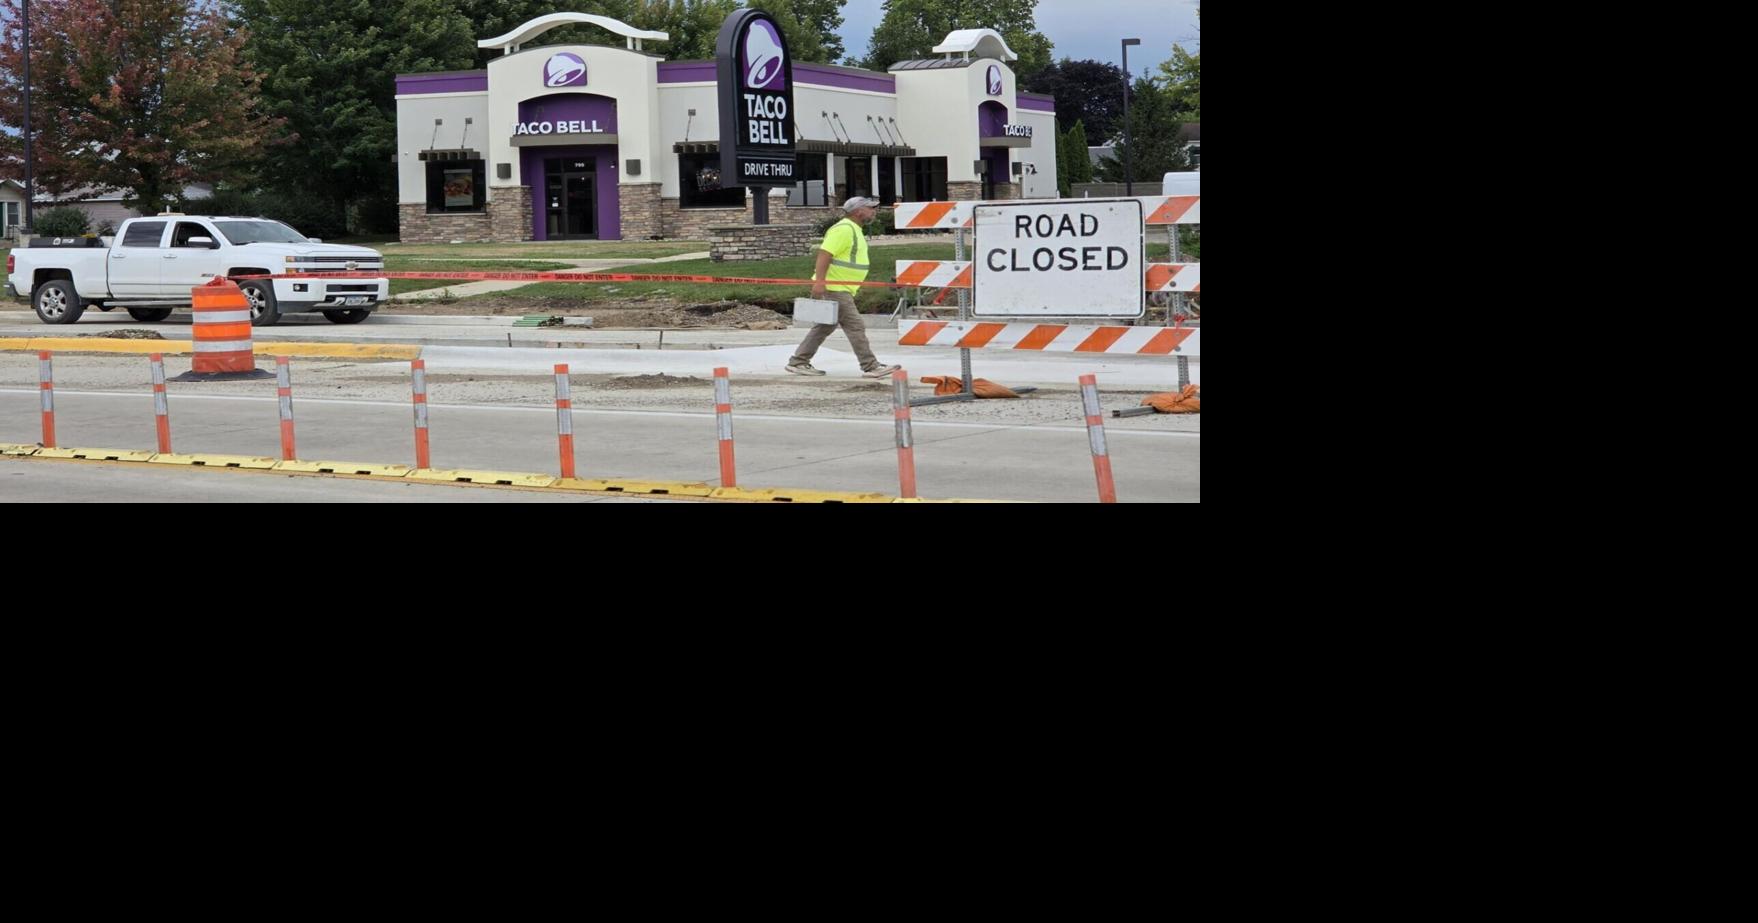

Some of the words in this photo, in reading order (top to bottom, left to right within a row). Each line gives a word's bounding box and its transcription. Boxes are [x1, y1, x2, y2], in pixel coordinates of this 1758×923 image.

[744, 94, 787, 119] TACO
[512, 121, 553, 135] TACO
[556, 120, 603, 133] BELL
[748, 119, 788, 144] BELL
[1003, 124, 1025, 137] TACO
[744, 163, 769, 176] DRIVE
[770, 163, 792, 176] THRU
[1015, 213, 1099, 238] ROAD
[987, 246, 1128, 272] CLOSED
